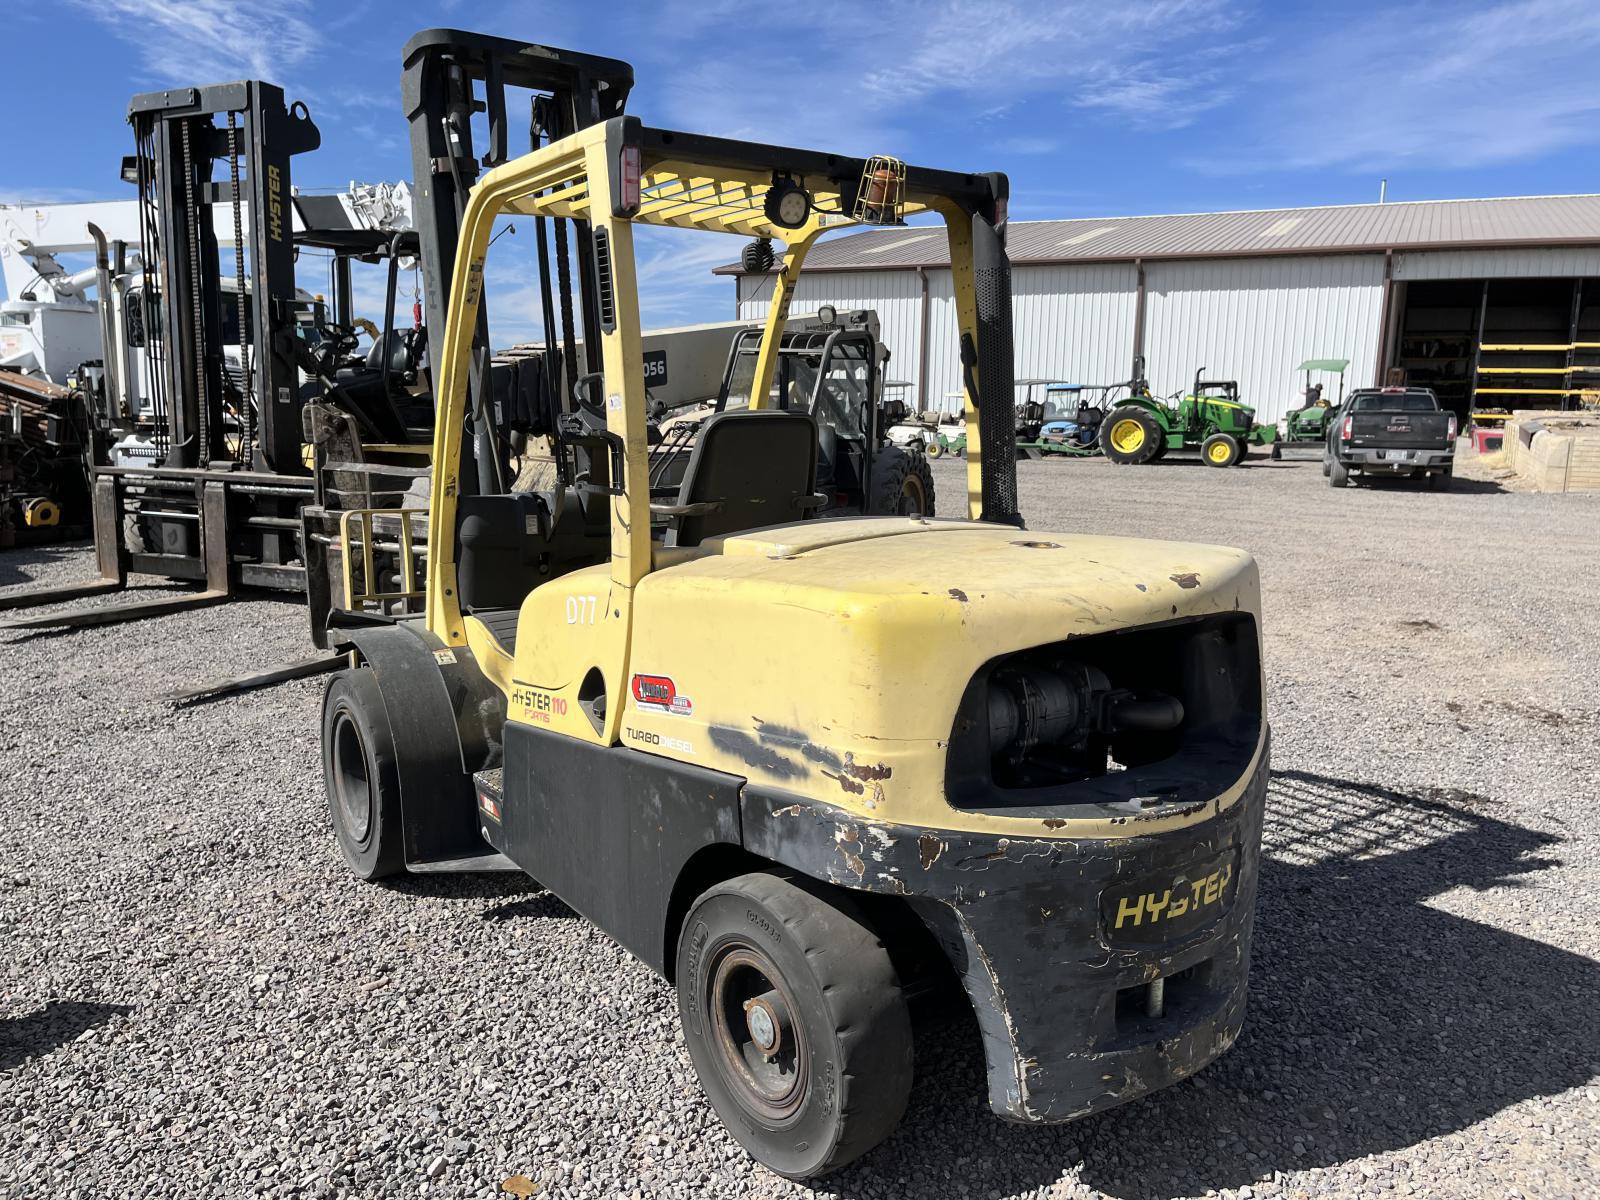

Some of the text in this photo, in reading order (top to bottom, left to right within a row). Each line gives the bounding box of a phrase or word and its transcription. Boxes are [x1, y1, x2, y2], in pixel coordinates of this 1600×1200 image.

[268, 164, 282, 242] HYSTER
[566, 596, 597, 624] D77
[552, 697, 567, 716] 110
